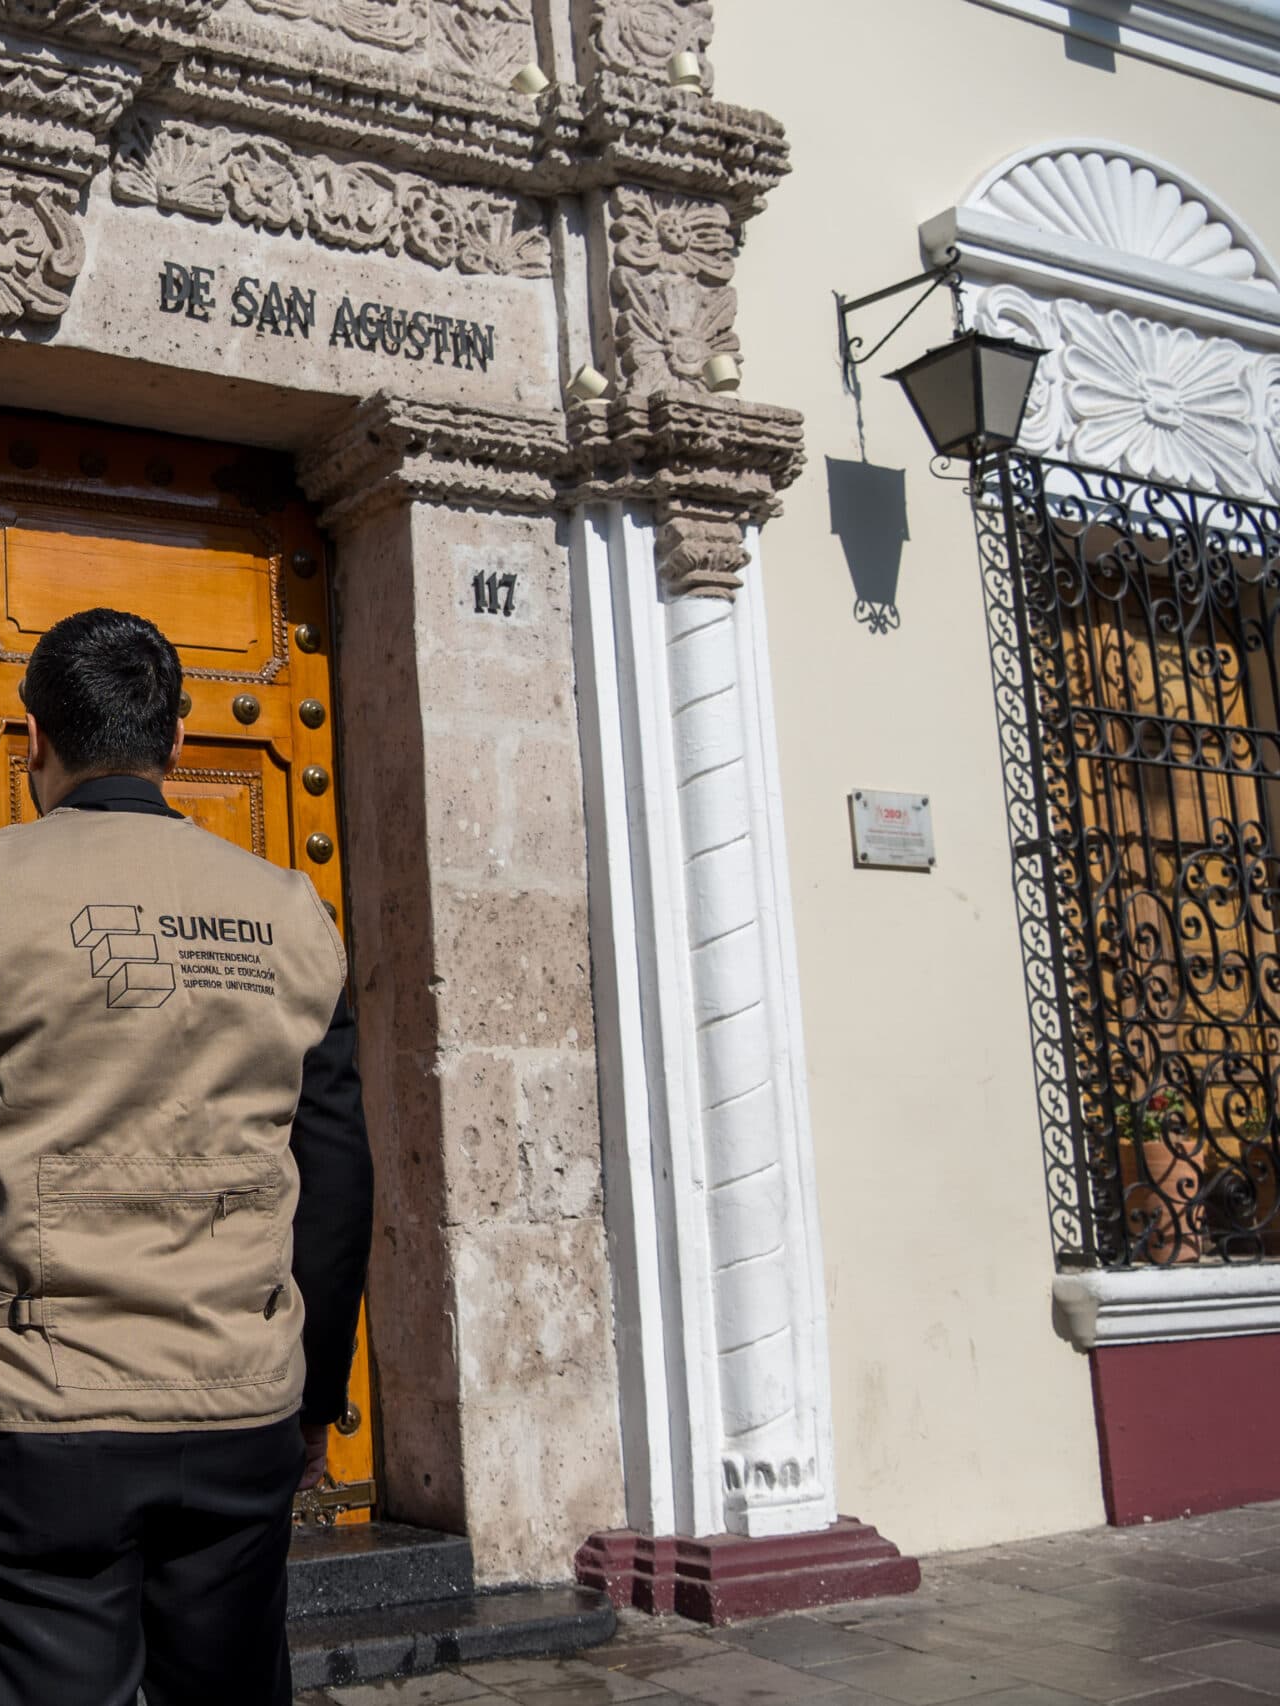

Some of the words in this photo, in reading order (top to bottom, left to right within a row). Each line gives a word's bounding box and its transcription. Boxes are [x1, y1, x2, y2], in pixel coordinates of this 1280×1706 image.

[162, 261, 216, 312] DE
[235, 275, 317, 330] SAN
[332, 296, 495, 363] AGUSTIN
[472, 569, 517, 612] 117
[158, 915, 274, 946] SUNEDU
[178, 950, 262, 964] SUPERINTENDENCIA
[180, 964, 222, 975] NACIONAL
[224, 966, 236, 976] DE
[237, 967, 276, 981] EDUCACIÓN
[182, 979, 223, 989] SUPERIOR
[225, 980, 276, 996] UNIVERSITARIA
